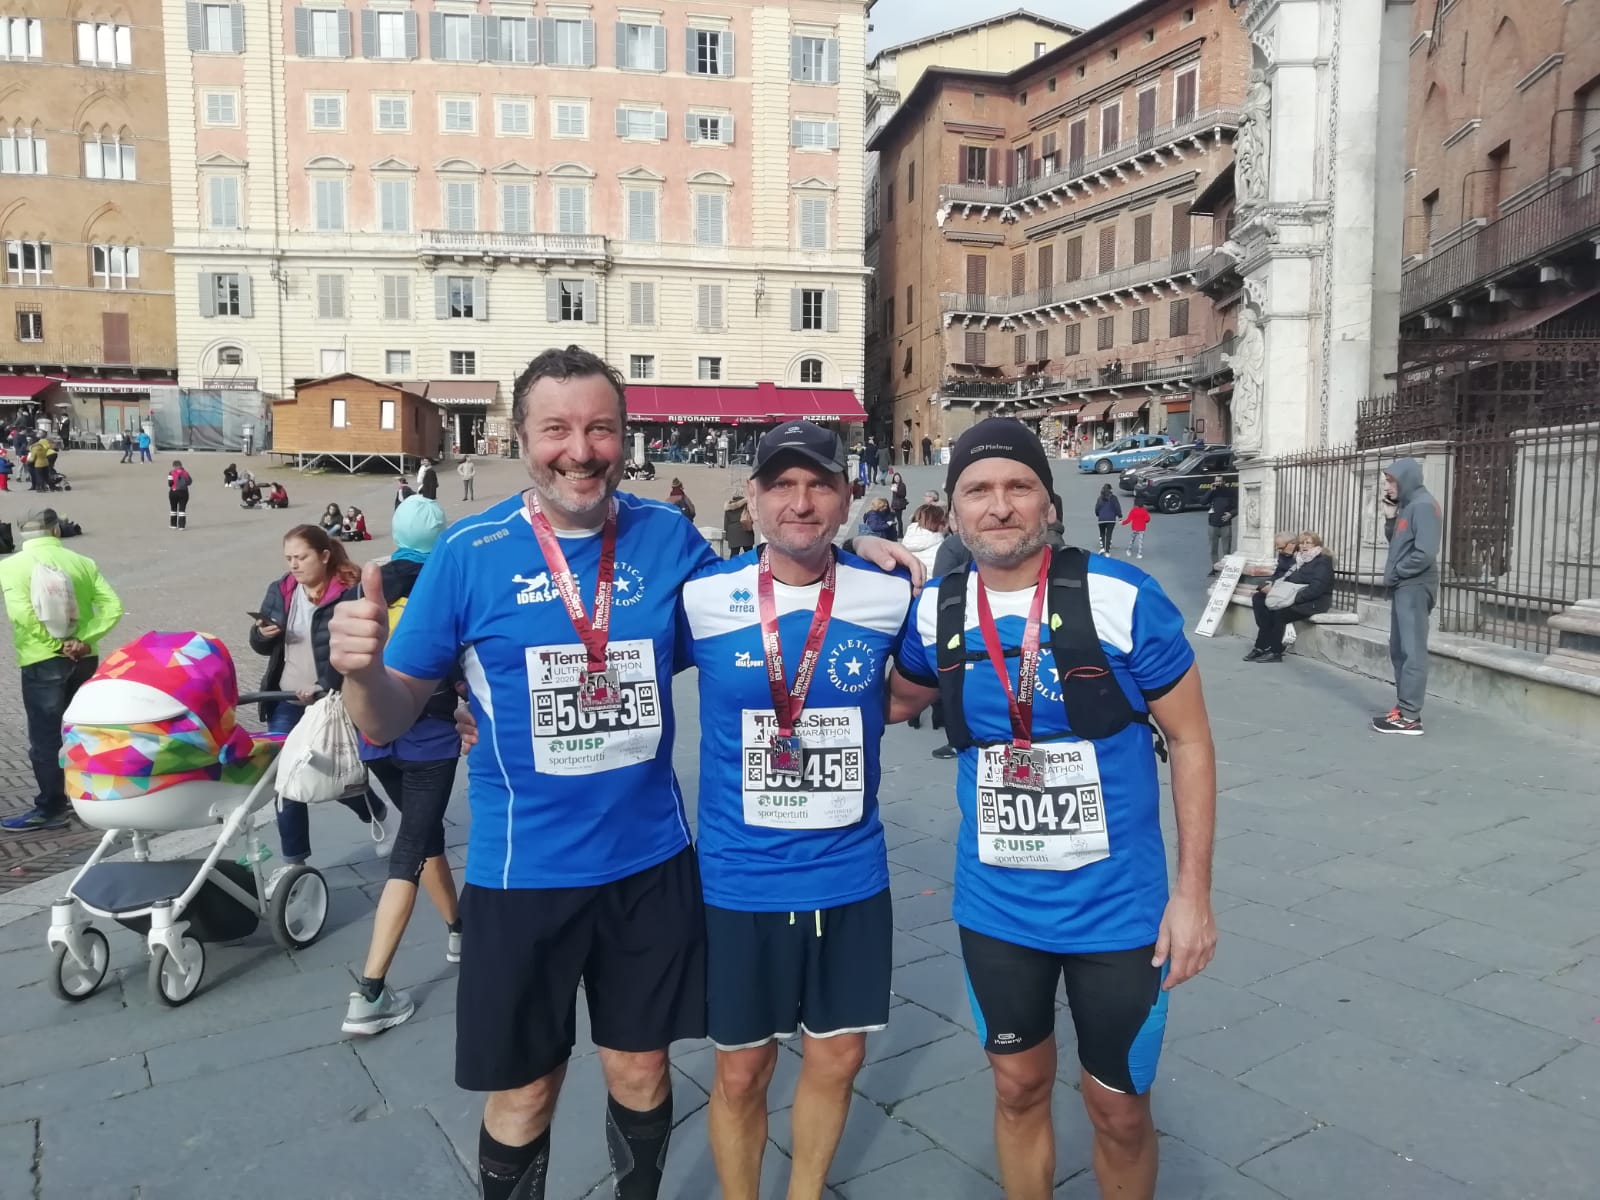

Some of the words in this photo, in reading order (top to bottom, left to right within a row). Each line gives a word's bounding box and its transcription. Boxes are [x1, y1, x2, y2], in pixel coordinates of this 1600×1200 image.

[516, 590, 561, 605] IDEASP
[729, 603, 755, 613] errea
[566, 737, 605, 752] UISP
[549, 752, 605, 767] sportpertutti
[773, 795, 808, 806] UISP
[758, 809, 809, 819] sportpertutti
[997, 792, 1080, 831] 5042
[1008, 838, 1045, 851] UISP
[994, 854, 1049, 864] sportpertutti
